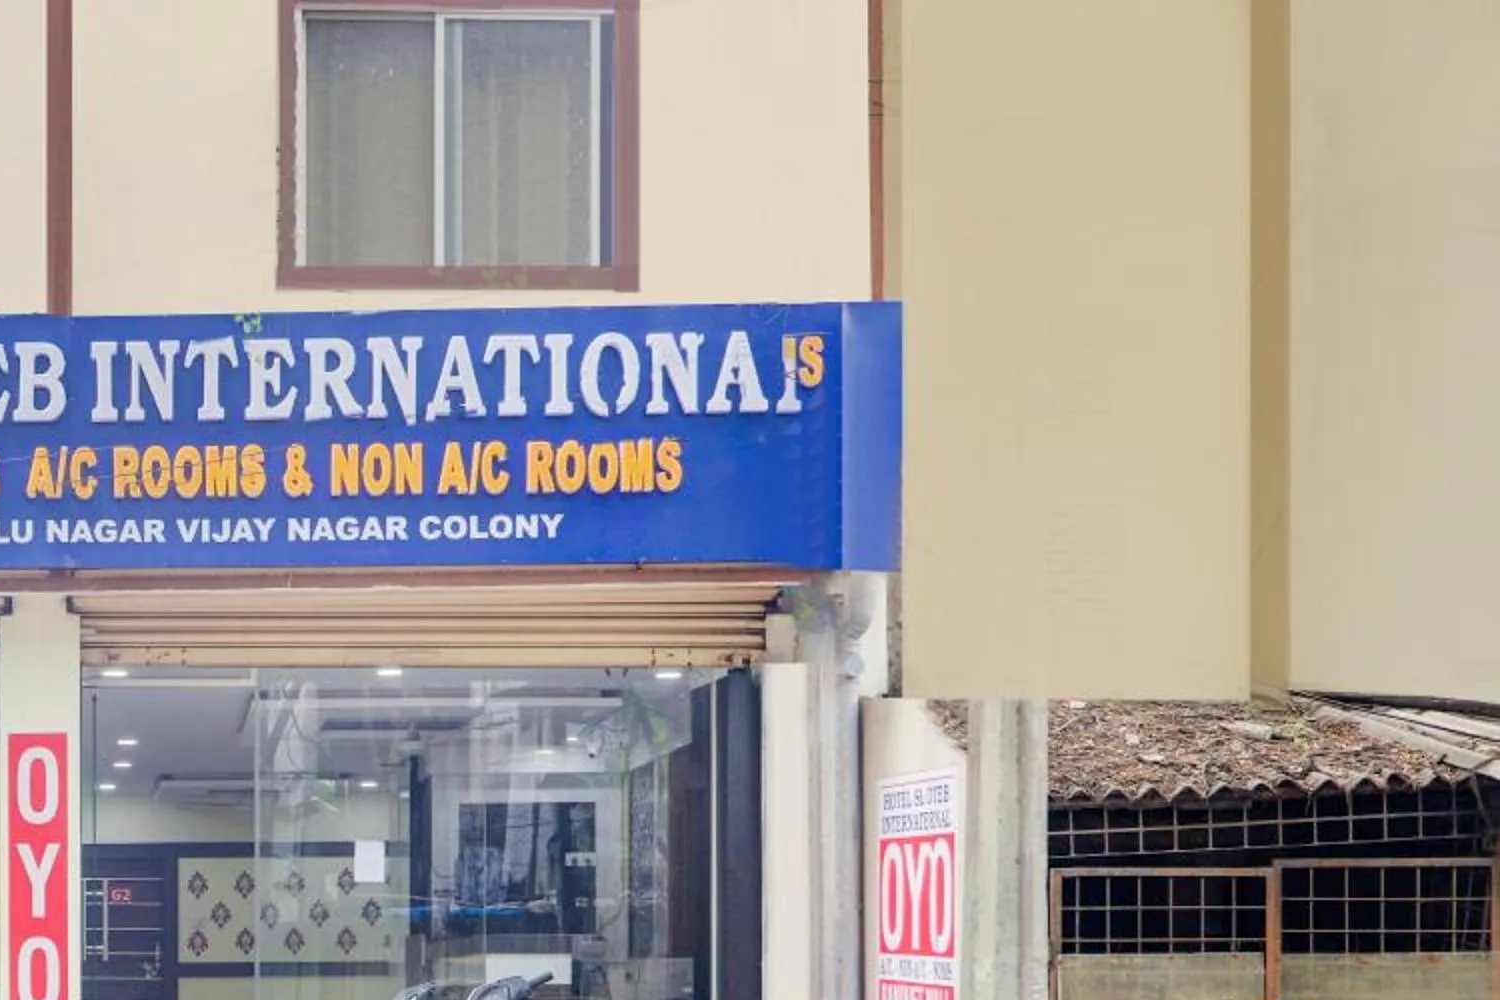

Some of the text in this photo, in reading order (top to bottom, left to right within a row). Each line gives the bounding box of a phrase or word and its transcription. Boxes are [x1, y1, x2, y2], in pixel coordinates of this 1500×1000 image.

[26, 445, 98, 499] A/C
[113, 444, 267, 499] ROOMS
[283, 443, 313, 497] &
[331, 441, 424, 497] NON
[438, 440, 509, 495] A/C
[526, 437, 684, 494] ROOMS
[46, 518, 165, 544] NAGAR
[175, 517, 275, 542] VIJAY
[287, 515, 407, 541] NAGAR
[418, 513, 565, 540] COLONY
[881, 836, 952, 954] OYO
